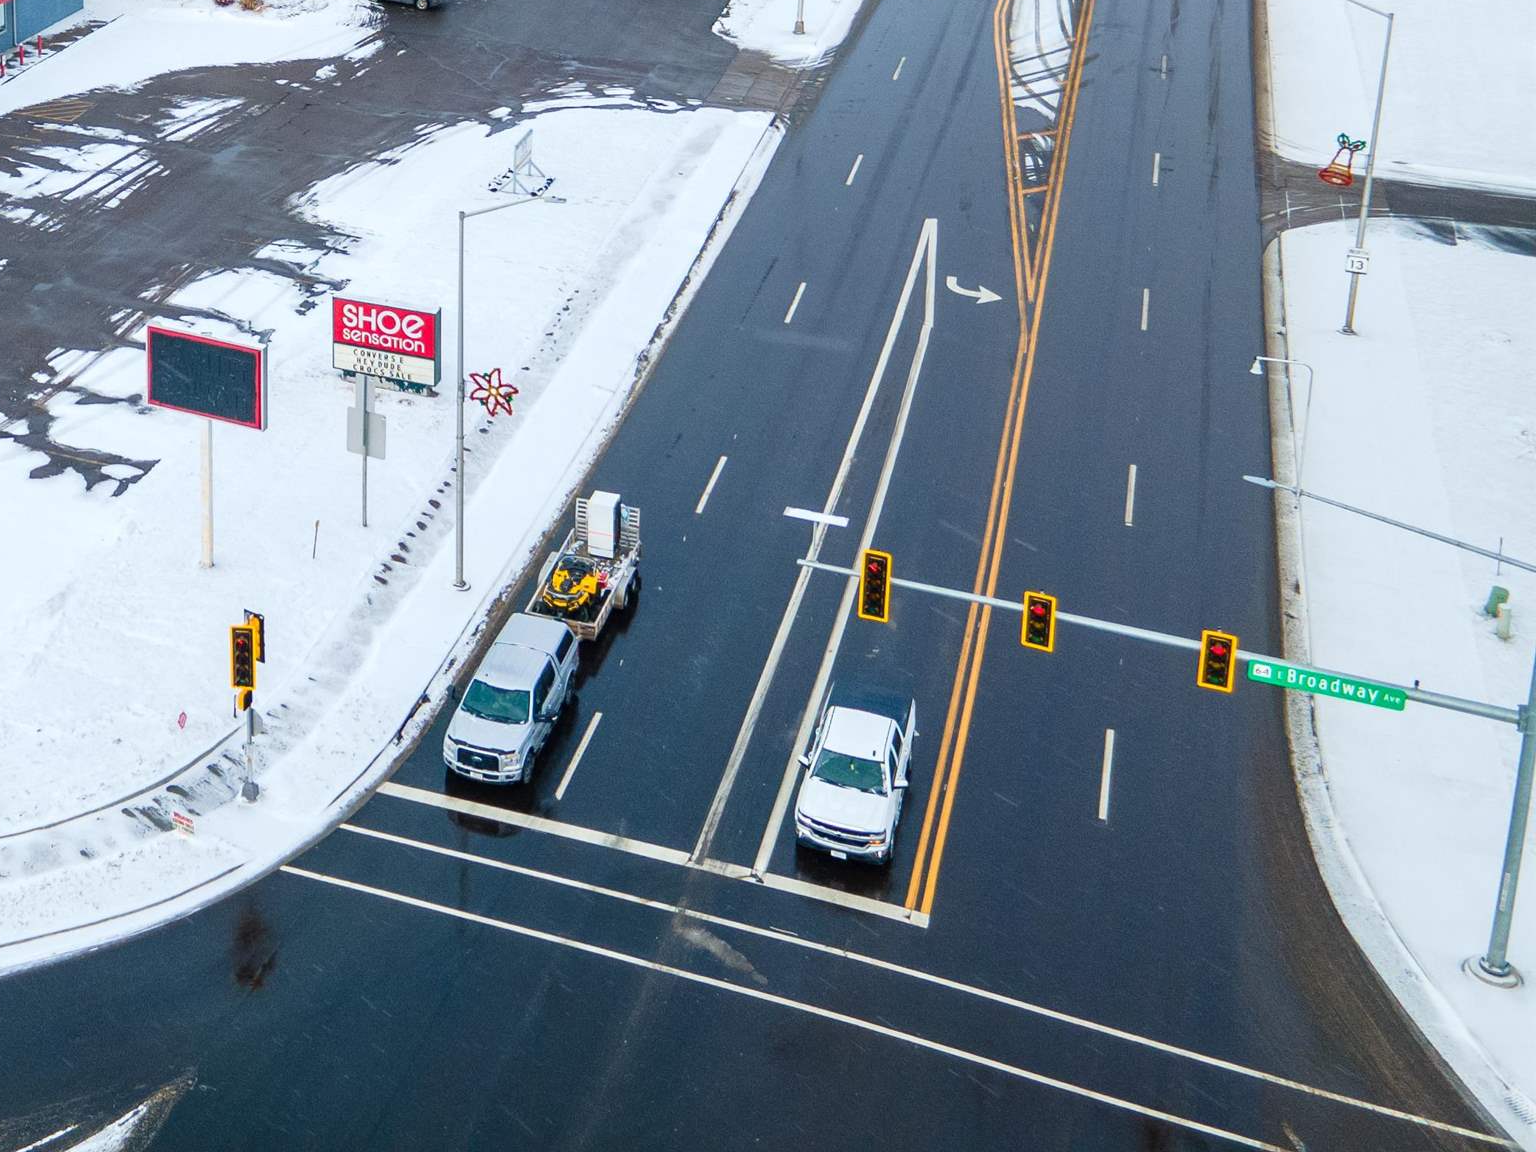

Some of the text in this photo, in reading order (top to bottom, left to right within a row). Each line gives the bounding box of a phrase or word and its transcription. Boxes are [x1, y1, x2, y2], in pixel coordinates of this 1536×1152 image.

[1351, 259, 1364, 270] 13
[353, 348, 404, 364] CONVERSE
[356, 356, 375, 367] HEY
[352, 363, 412, 381] CROCS SALE
[1287, 668, 1379, 703] Broadway
[1383, 692, 1402, 705] Ave
